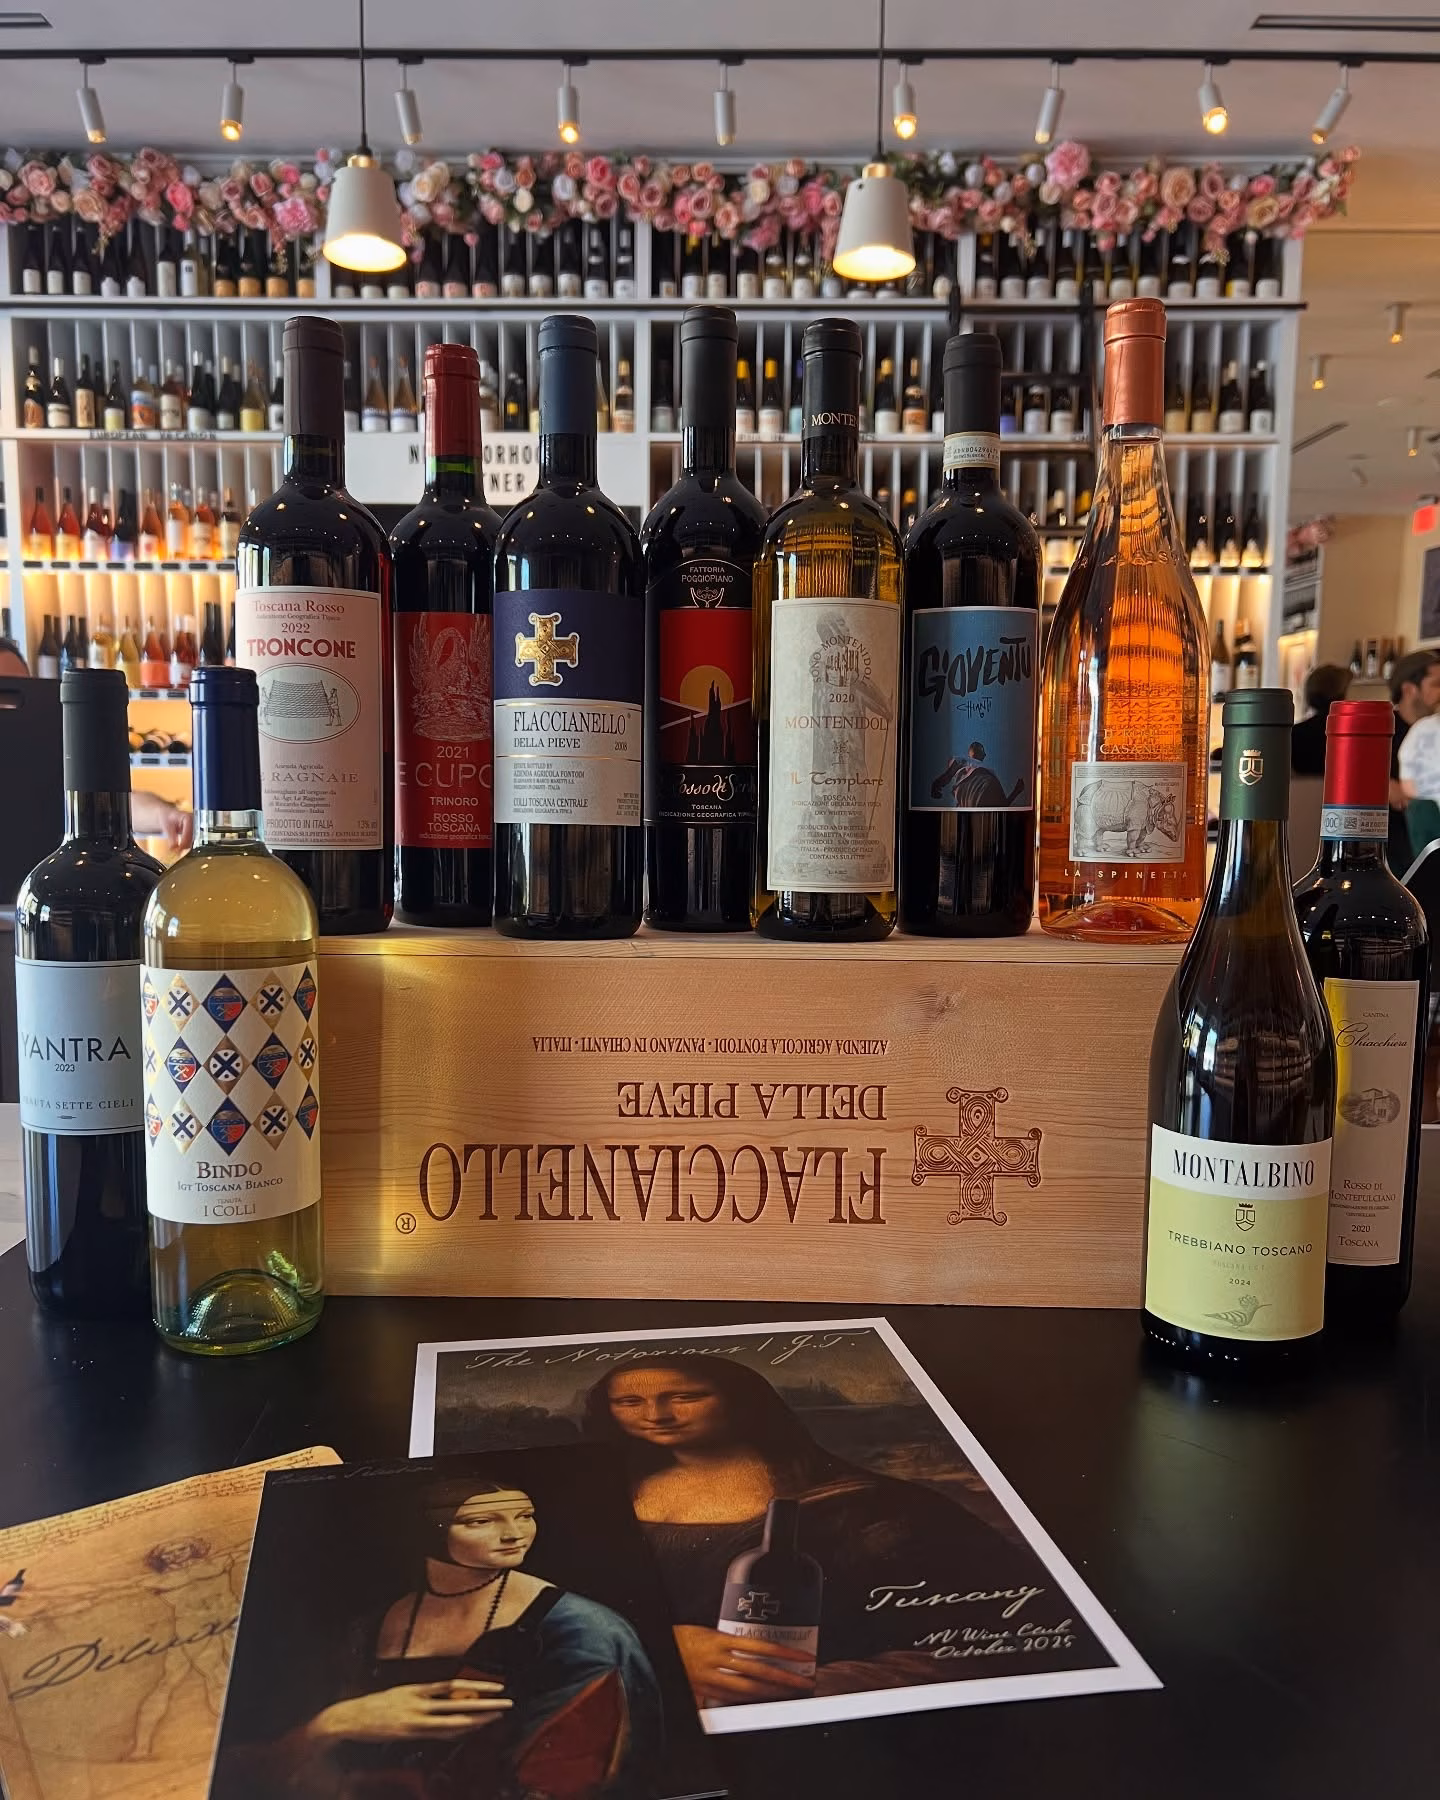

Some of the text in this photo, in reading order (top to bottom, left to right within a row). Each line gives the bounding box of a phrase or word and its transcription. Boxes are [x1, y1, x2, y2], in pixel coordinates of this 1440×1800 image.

[811, 412, 859, 427] MONTEN
[489, 472, 526, 493] NER
[681, 574, 734, 583] POGGIOPIANO
[255, 600, 345, 614] Toscana Rosso
[281, 622, 311, 634] 2022
[246, 637, 356, 659] TRONCONE
[828, 693, 855, 703] 2020
[513, 710, 626, 735] FLACCIANELLO
[513, 737, 545, 748] DELLA
[547, 737, 581, 749] PIEVE
[436, 746, 470, 759] 2021
[271, 772, 359, 784] RAGNAIE
[533, 770, 560, 778] AGRICOLA
[809, 771, 884, 792] Templare
[429, 796, 479, 807] TRINORO
[528, 797, 556, 807] TOSCANA
[556, 798, 589, 808] CENTRALE
[823, 794, 856, 802] TOSCANA
[266, 818, 301, 829] PRODOTTO
[303, 819, 311, 829] IN
[312, 819, 334, 830] ITALIA
[433, 813, 474, 823] ROSSO
[427, 822, 481, 833] TOSCANA
[1064, 868, 1188, 879] LA SPINETTA
[21, 1032, 132, 1063] YANTRA
[532, 1036, 889, 1056] AZIENDA AGRICOLA FONTODI PANZANO IN CHIANTI ITALIA
[54, 1063, 76, 1072] 2023
[55, 1101, 94, 1110] SETTE
[98, 1098, 134, 1110] CIELI
[617, 1082, 888, 1121] DELLA PIEVE
[1172, 1149, 1315, 1188] MONTALBINO
[419, 1142, 887, 1225] FLACCIANELLO
[212, 1203, 257, 1217] COLLI
[1351, 1224, 1371, 1233] 2020
[1168, 1230, 1313, 1257] TREBBIANO TOSCANO
[1229, 1278, 1251, 1286] 2024
[465, 1349, 534, 1369] The
[545, 1345, 748, 1365] Notorious
[865, 1580, 1046, 1619] Tuscany
[962, 1627, 1012, 1642] Wine
[1017, 1619, 1073, 1637] Club
[931, 1638, 1017, 1660] October
